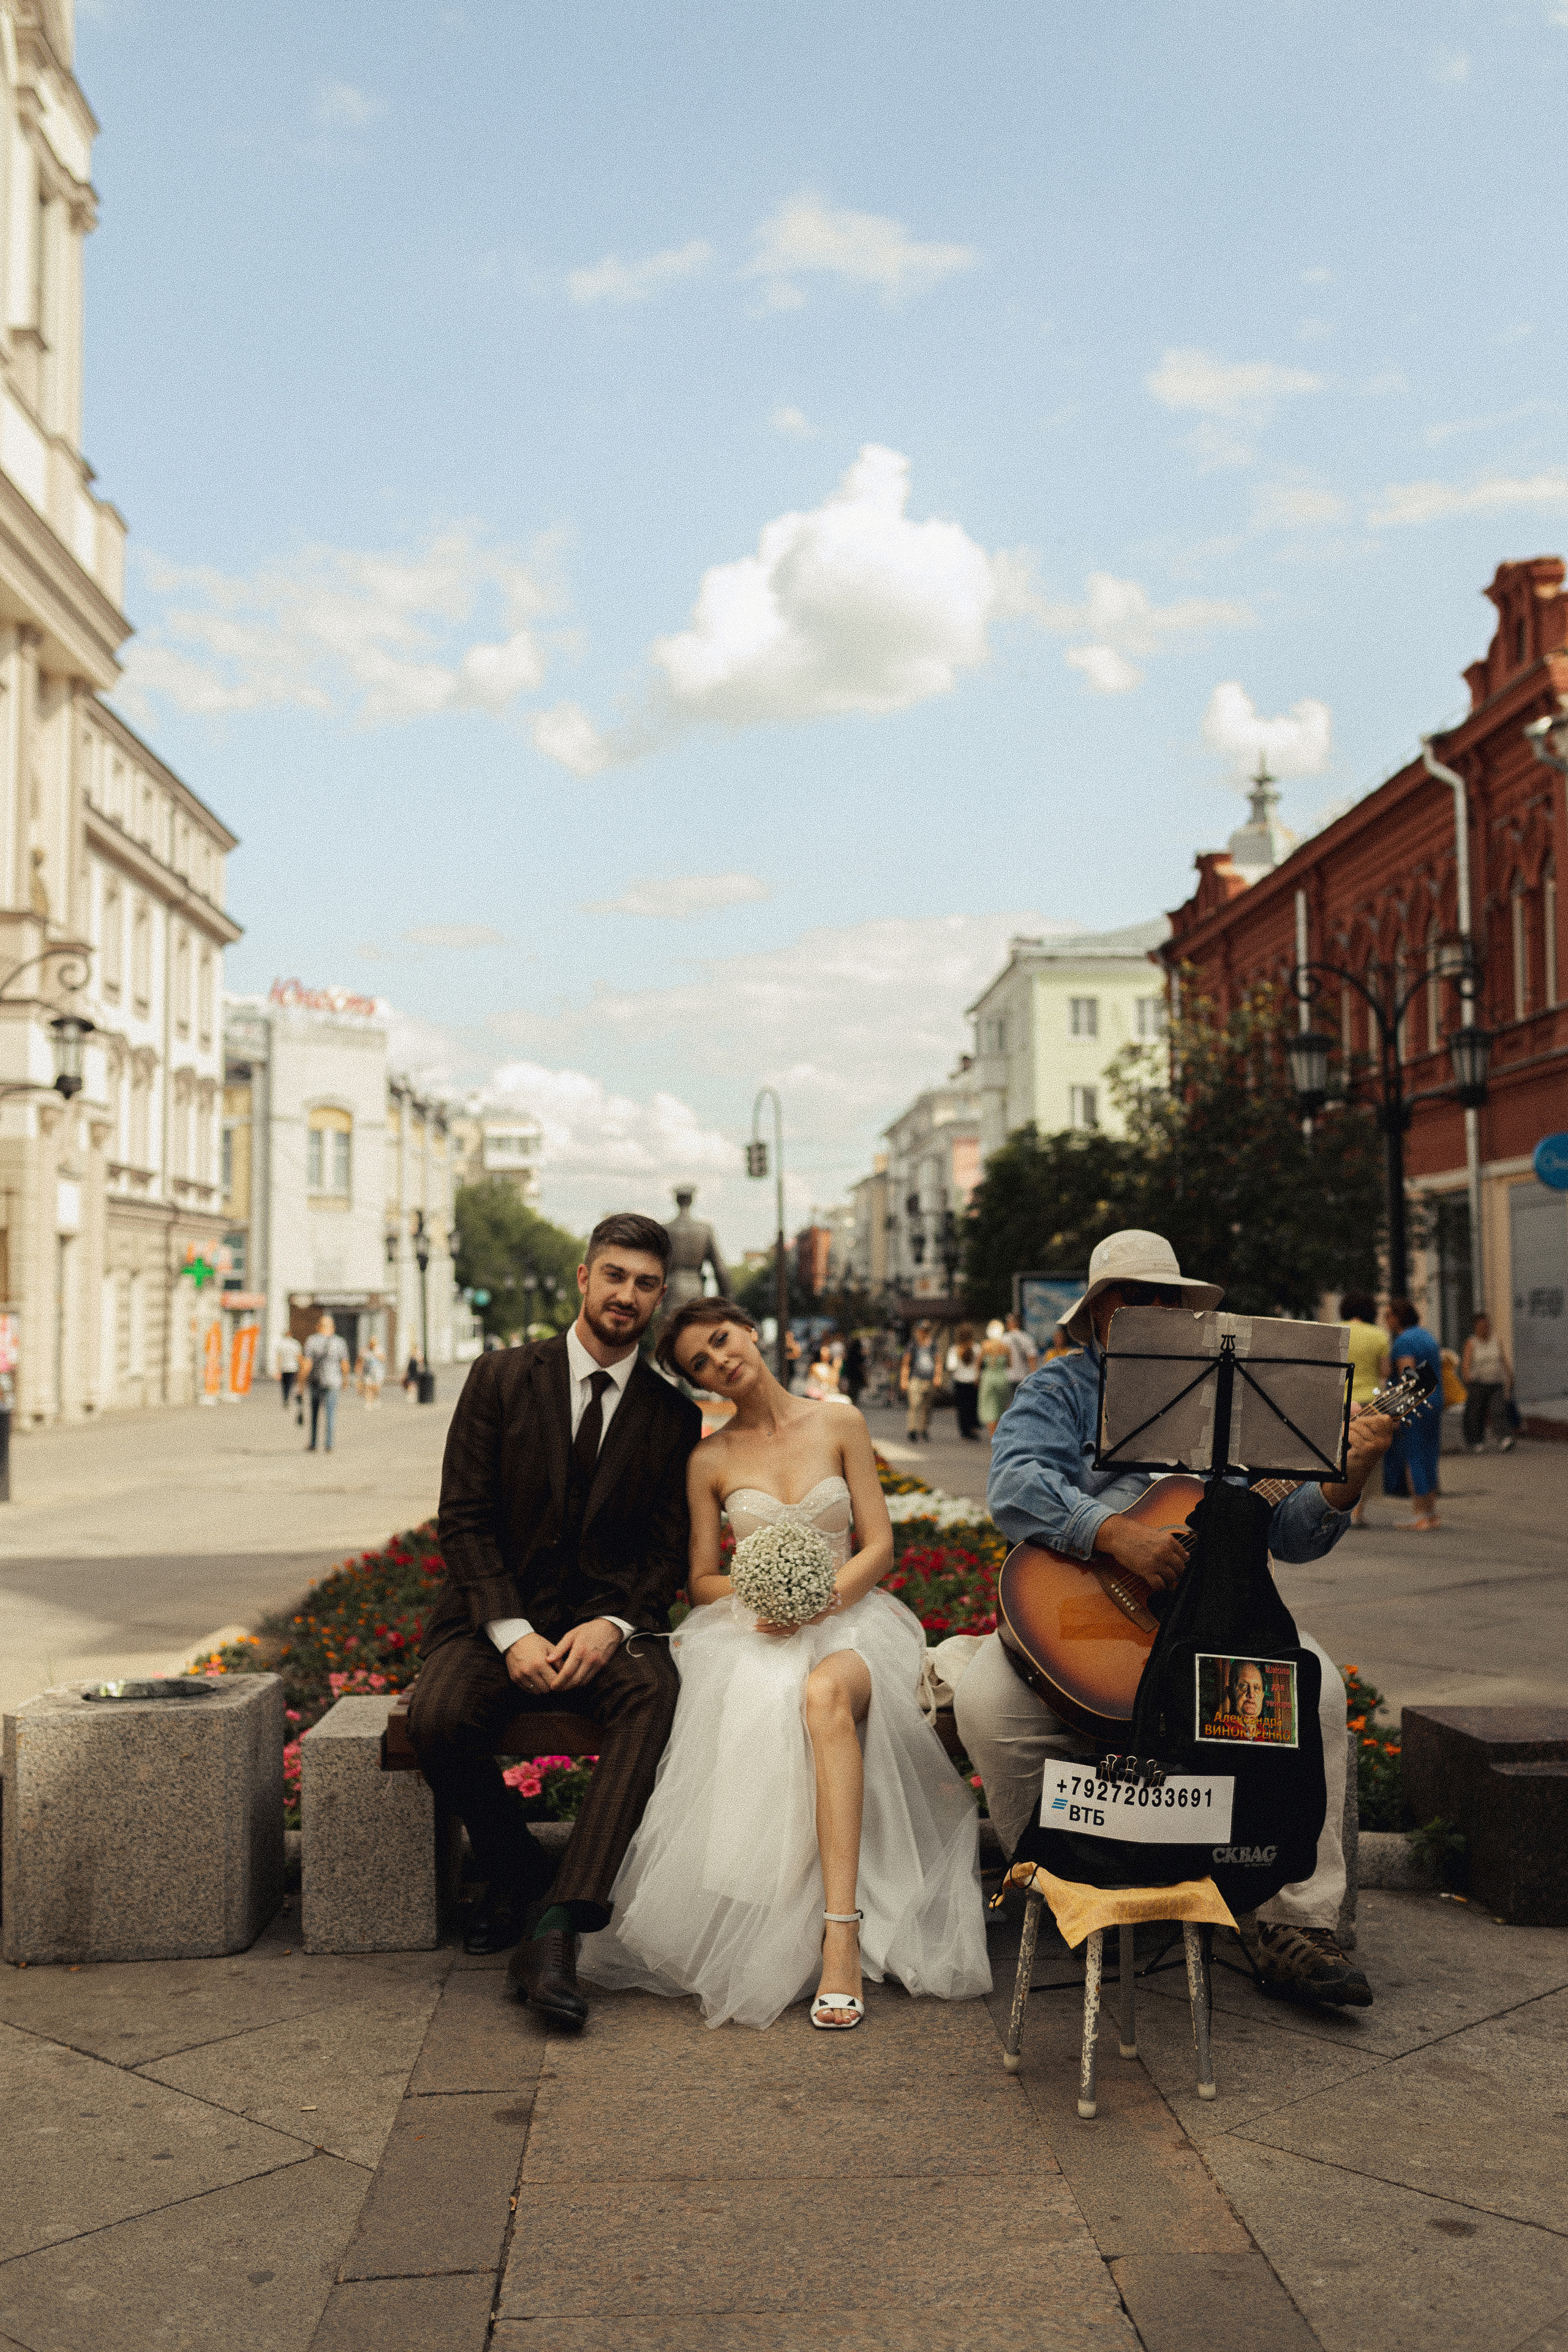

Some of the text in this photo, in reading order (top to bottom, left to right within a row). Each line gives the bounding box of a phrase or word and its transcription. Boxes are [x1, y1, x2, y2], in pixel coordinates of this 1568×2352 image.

[1265, 1665, 1290, 1675] Школа
[1214, 1712, 1282, 1728] Александра
[1205, 1724, 1291, 1741] ВИНОКУРЕНКО
[1057, 1776, 1212, 1807] +79272033691
[1069, 1804, 1105, 1826] ВТБ
